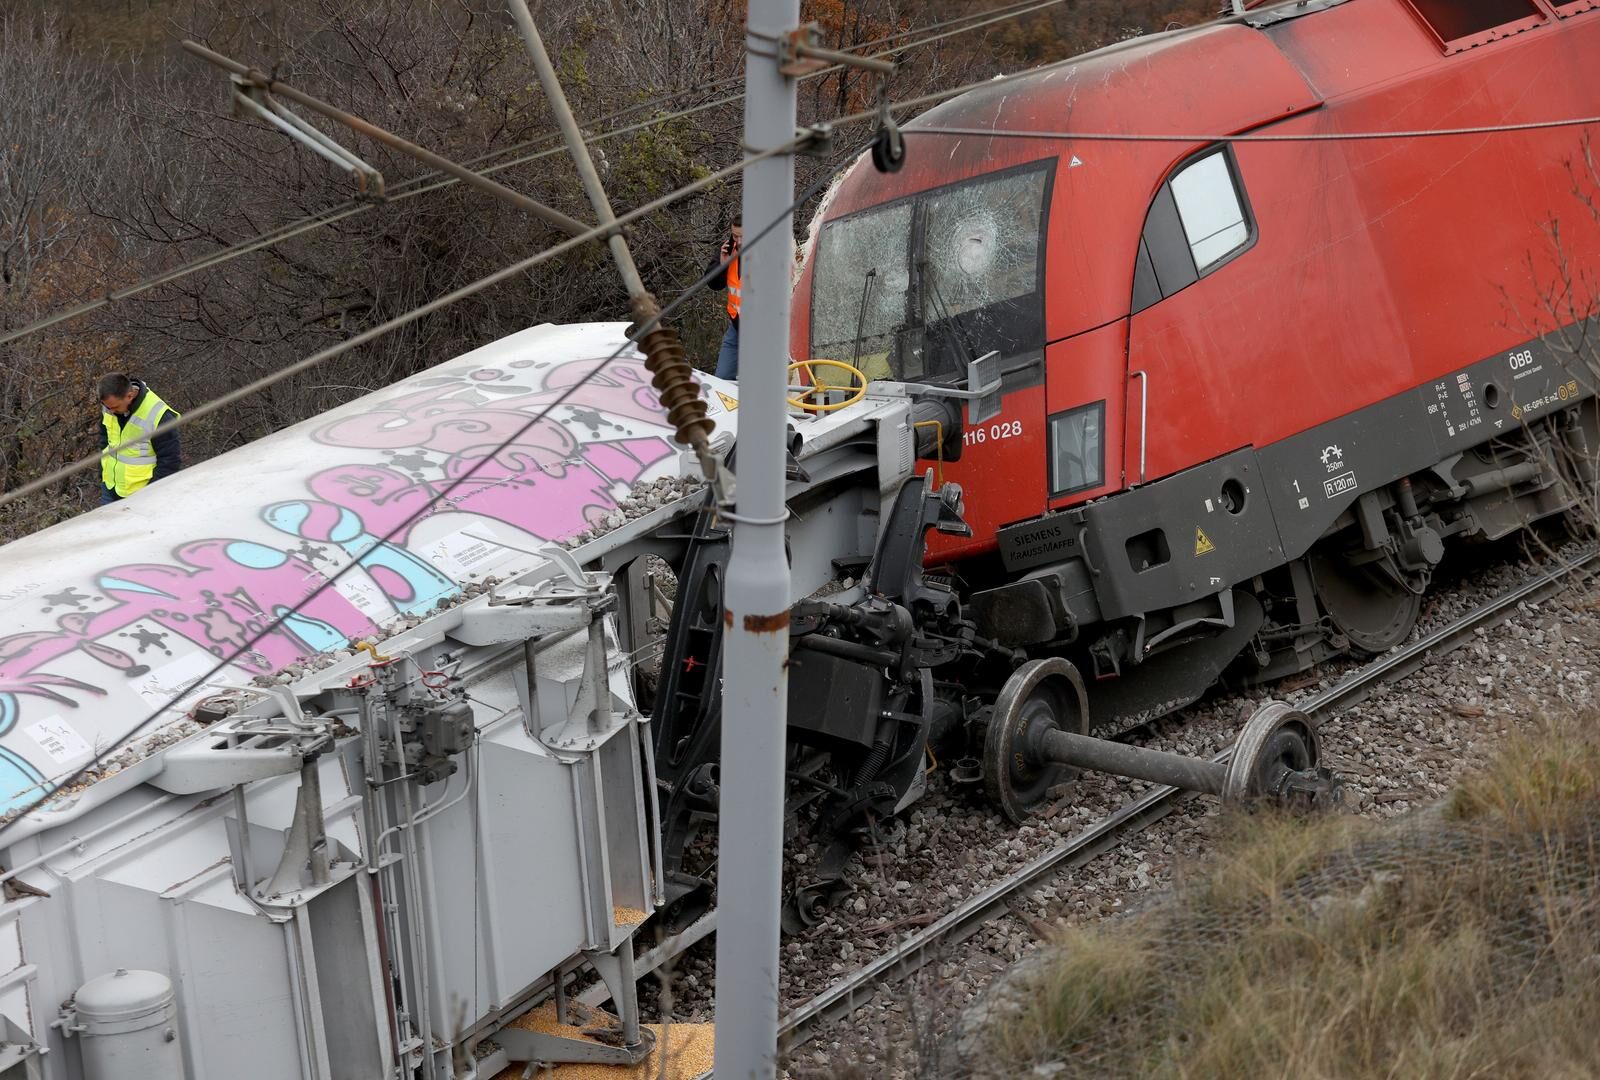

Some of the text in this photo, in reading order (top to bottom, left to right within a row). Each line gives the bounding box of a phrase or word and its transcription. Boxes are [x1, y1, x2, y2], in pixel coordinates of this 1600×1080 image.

[1509, 349, 1533, 370] ÖBB
[990, 420, 1023, 440] 028
[1293, 479, 1301, 493] 1
[1326, 483, 1334, 495] R
[1014, 526, 1062, 546] SIEMENS
